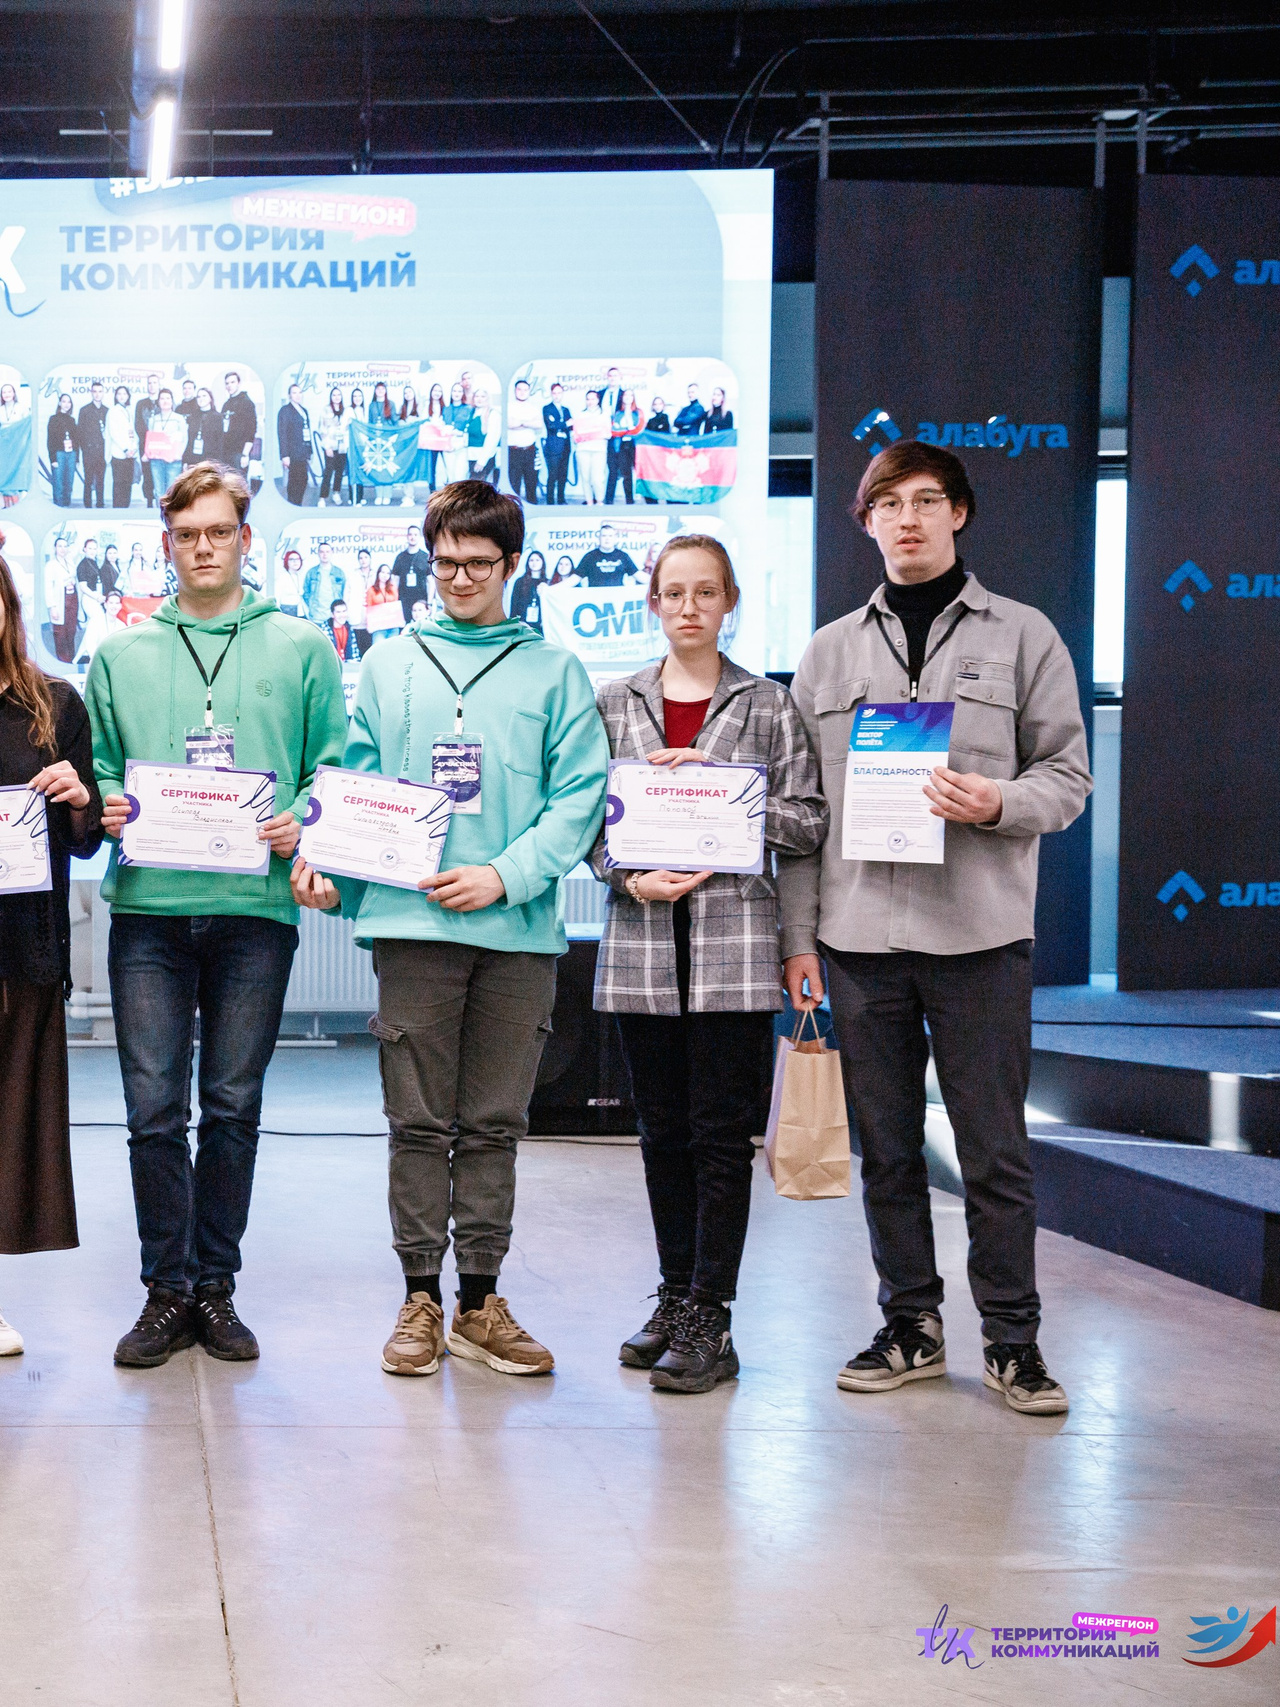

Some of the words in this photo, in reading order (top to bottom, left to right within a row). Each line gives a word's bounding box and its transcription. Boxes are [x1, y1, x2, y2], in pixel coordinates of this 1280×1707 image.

[244, 196, 407, 226] МЕЖРЕГИОН
[59, 223, 325, 253] ТЕРРИТОРИЯ
[59, 252, 417, 292] КОММУНИКАЦИЙ
[916, 414, 1069, 458] алабуга
[853, 767, 932, 776] БЛАГОДАРНОСТЬ
[161, 788, 240, 803] СЕРТИФИКАТ
[645, 787, 729, 798] СЕРТИФИКАТ
[343, 795, 417, 816] СЕРТИФИКАТ
